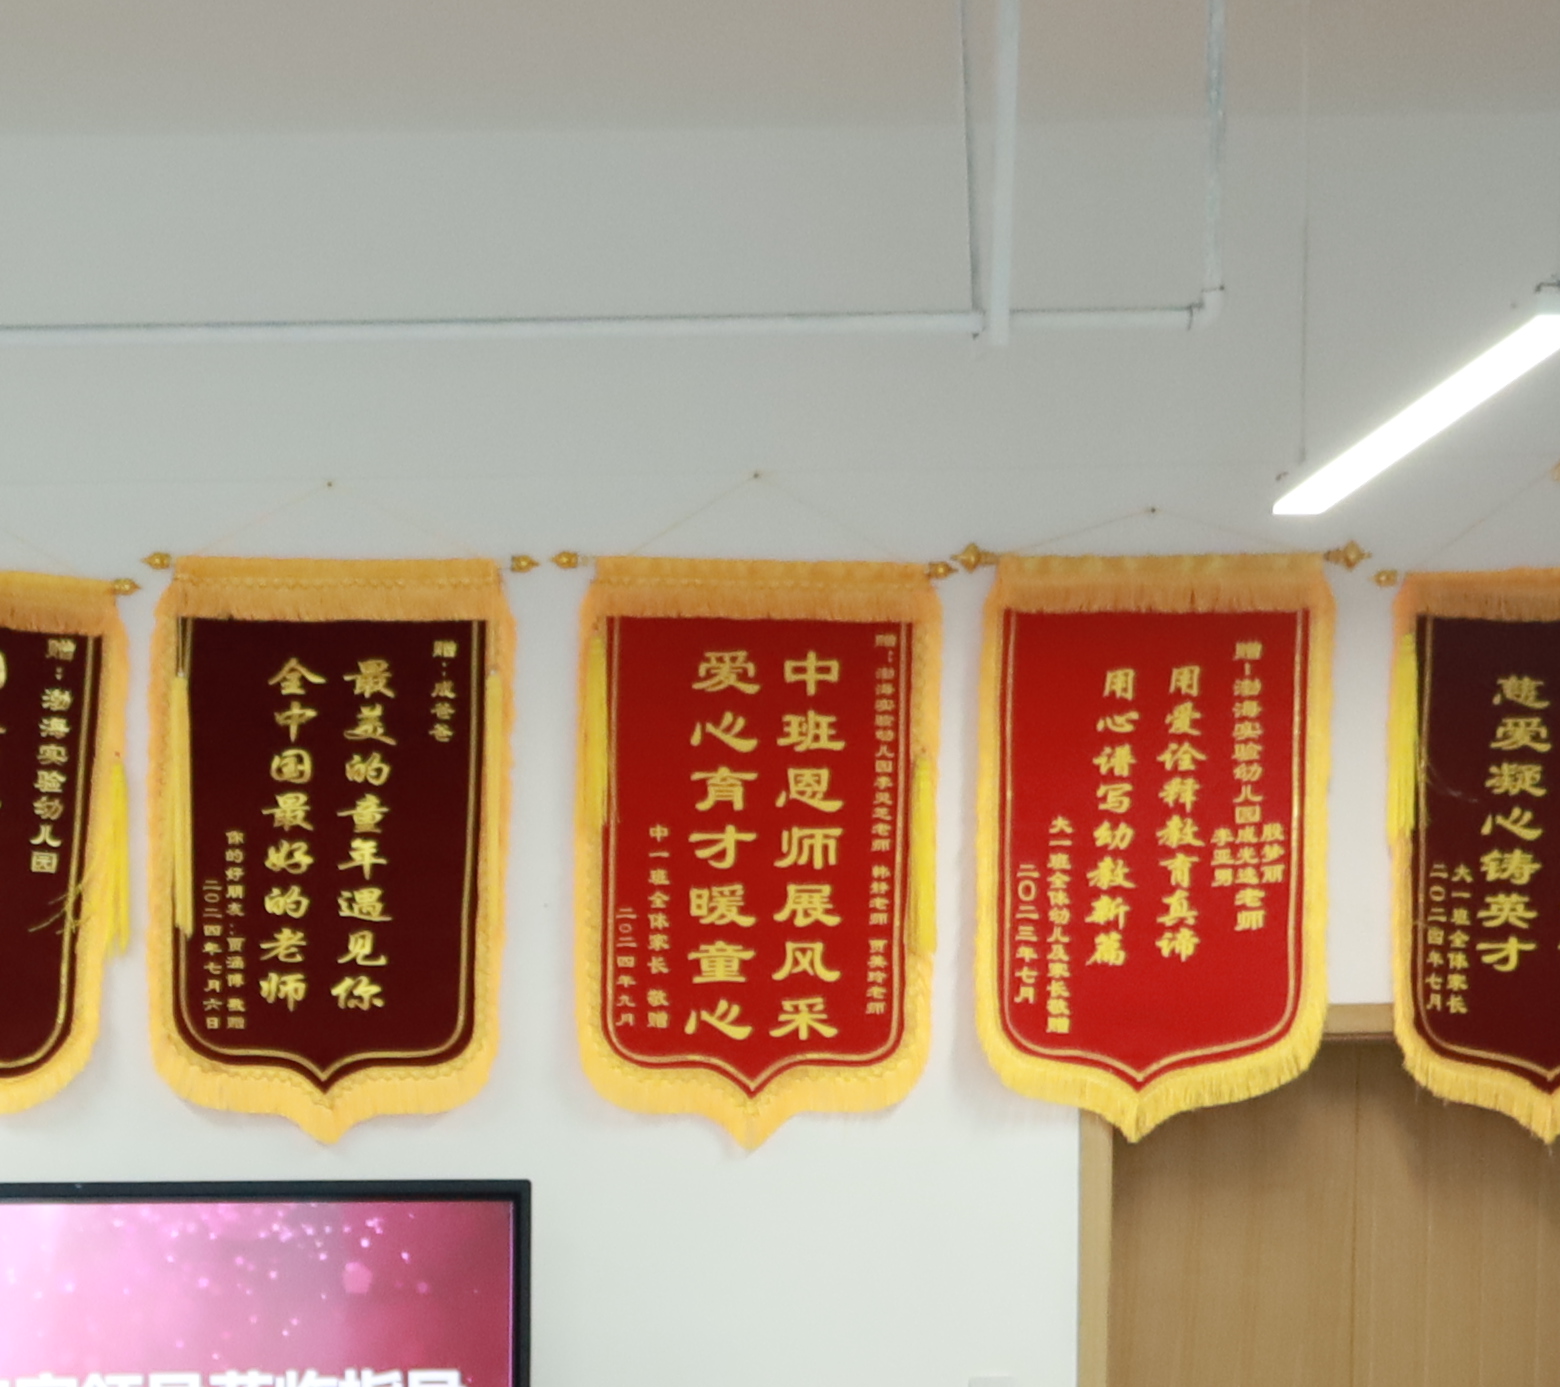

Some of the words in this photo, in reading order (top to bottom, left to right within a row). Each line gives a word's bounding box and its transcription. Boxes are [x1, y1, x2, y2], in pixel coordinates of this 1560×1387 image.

[30, 637, 77, 874] 赠：渤海实验幼儿园
[259, 657, 326, 1012] 全中国最好的老师
[331, 659, 396, 1011] 最美的童年遇见你
[647, 823, 670, 974] 中一班全体家长
[684, 650, 761, 1041] 爱心育才暖童心
[769, 650, 845, 1041] 中班恩师展风采
[1085, 668, 1140, 967] 用心谱写幼教新篇
[1156, 665, 1207, 963] 用爱诠释教育真谛
[1475, 675, 1552, 973] 慈爱凝心铸英才
[1046, 816, 1073, 1034] 大一班全体幼儿及家长敬赠
[1446, 863, 1473, 1014] 大一班全体家长
